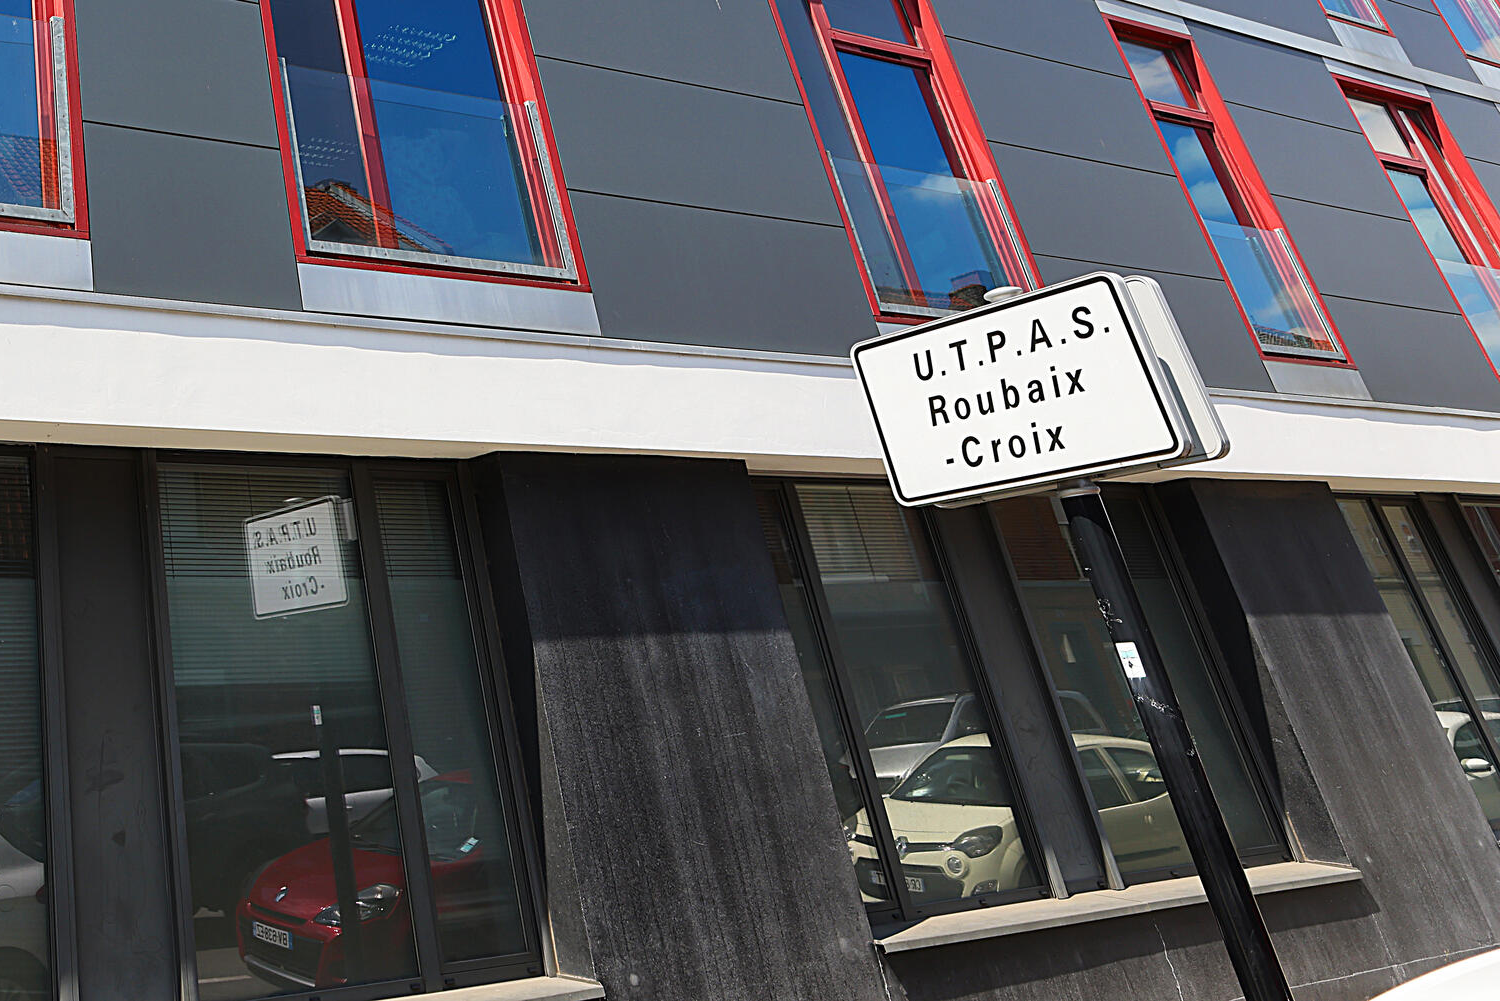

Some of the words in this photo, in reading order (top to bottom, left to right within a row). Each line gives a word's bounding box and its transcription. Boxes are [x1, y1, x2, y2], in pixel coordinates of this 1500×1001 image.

[912, 305, 1111, 381] U.T.P.A.S.
[928, 365, 1086, 427] Roubaix
[946, 422, 1066, 468] -Croix
